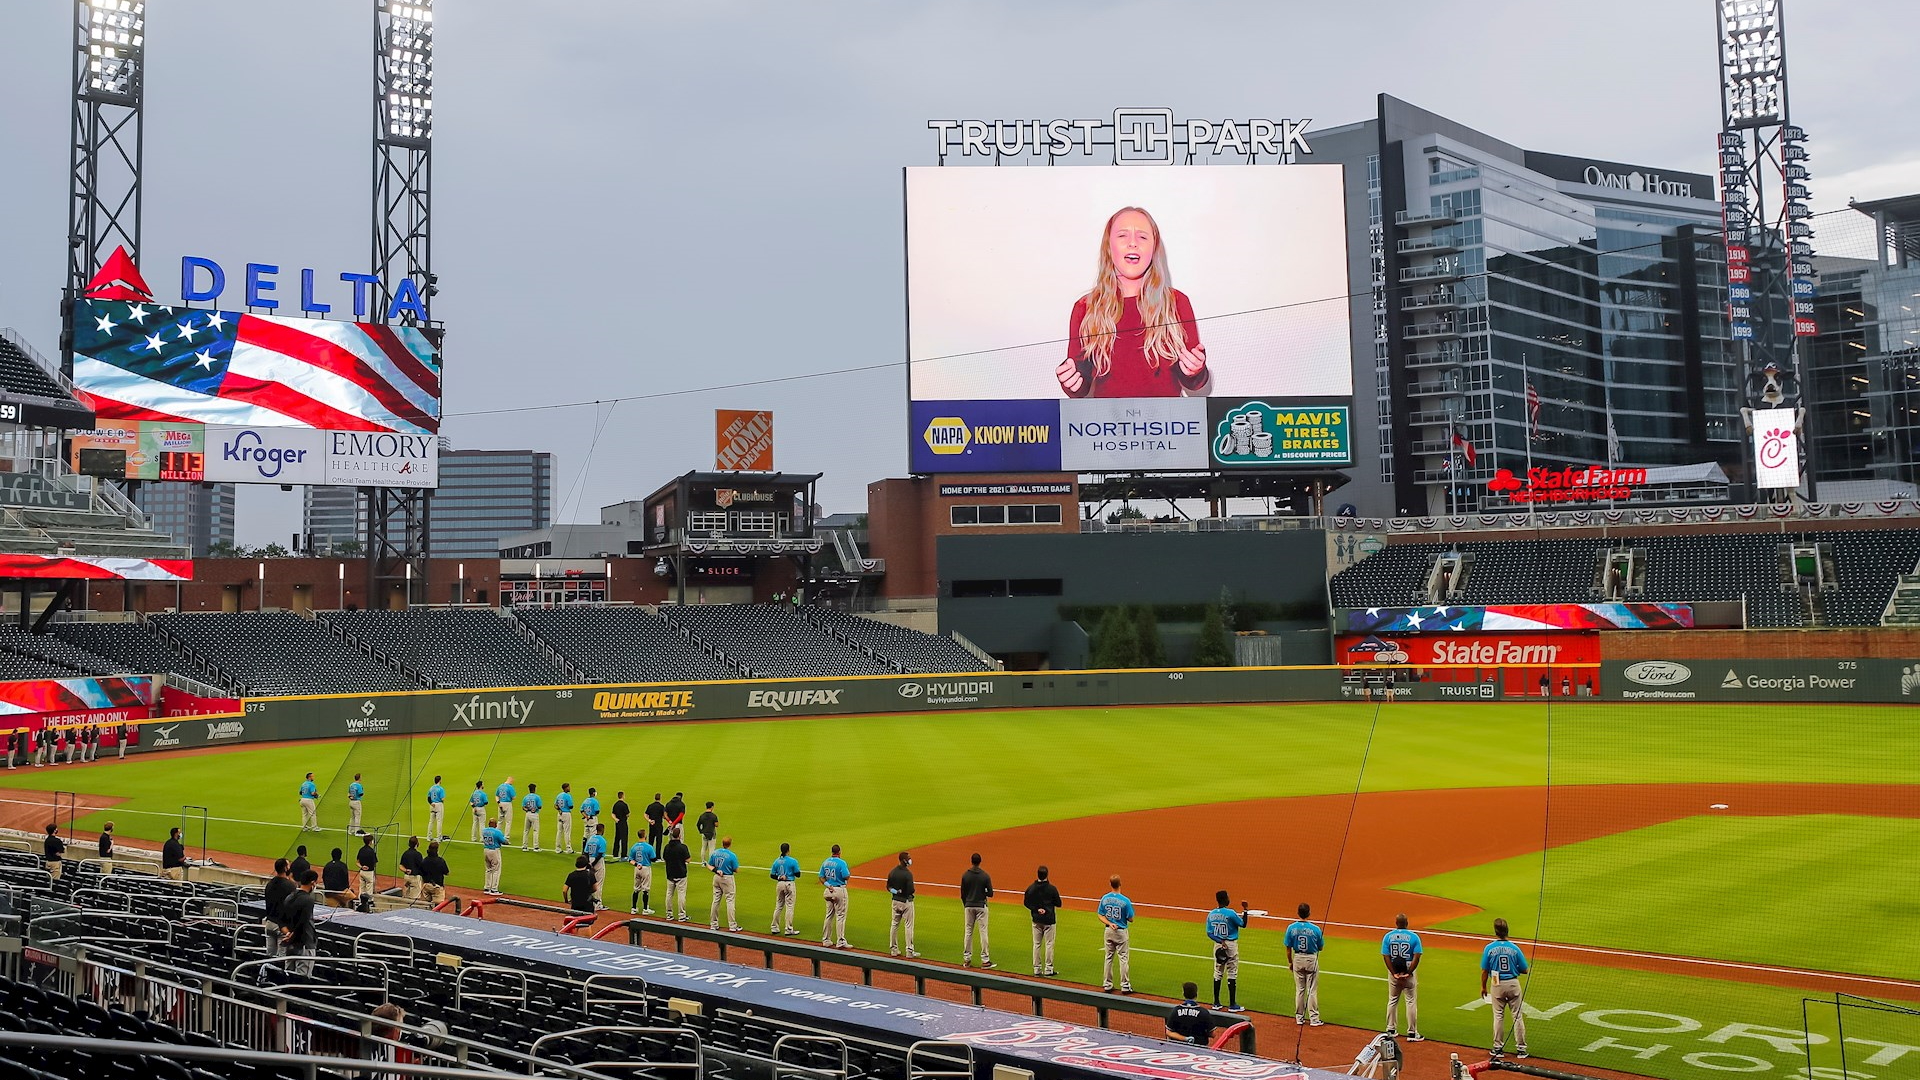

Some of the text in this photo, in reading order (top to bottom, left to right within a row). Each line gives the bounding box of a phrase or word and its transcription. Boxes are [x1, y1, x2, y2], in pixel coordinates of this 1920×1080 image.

[928, 118, 1313, 156] TRUIST PARK
[1784, 129, 1802, 139] 1873
[1722, 136, 1740, 146] 1872
[1785, 148, 1803, 158] 1875
[1723, 155, 1741, 165] 1874
[1786, 168, 1805, 178] 1878
[1584, 165, 1693, 198] OMNI HOTEL
[1724, 174, 1742, 184] 1877
[1788, 187, 1806, 197] 1891
[1725, 193, 1745, 203] 1883
[1727, 212, 1745, 222] 1892
[1789, 208, 1808, 217] 1893
[1728, 231, 1746, 241] 1897
[1729, 250, 1747, 260] 1914
[1791, 245, 1810, 255] 1948
[1730, 269, 1748, 279] 1957
[1793, 264, 1812, 274] 1958
[181, 256, 427, 321] DELTA
[1731, 288, 1750, 298] 1969
[1794, 283, 1813, 294] 1982
[1733, 307, 1751, 317] 1991
[1795, 303, 1814, 313] 1992
[1734, 327, 1753, 337] 1993
[1797, 322, 1816, 333] 1995
[0, 405, 16, 419] 59
[1126, 409, 1141, 417] NH
[1276, 412, 1342, 426] MAVIS
[722, 416, 746, 440] THE
[1068, 421, 1201, 437] NORTHSIDE
[1284, 428, 1329, 438] TIRES
[165, 431, 191, 441] MEGA
[932, 427, 964, 445] NAPA
[974, 425, 1049, 444] KNOW HOW
[717, 411, 772, 469] HOME
[1282, 440, 1339, 449] BRAKES
[332, 433, 433, 458] EMORY
[1093, 441, 1177, 451] HOSPITAL
[224, 431, 307, 477] Kroger
[739, 433, 772, 470] DEPOT
[332, 461, 429, 474] HEALTHCARE
[161, 471, 203, 480] MILLION
[1510, 487, 1631, 503] NEIGHBORHOOD
[707, 567, 739, 575] SLICE
[1838, 662, 1857, 670] 375
[1638, 666, 1677, 681] Ford
[1747, 674, 1856, 691] Georgia Power
[927, 682, 993, 695] HYUNDAI
[1440, 687, 1478, 695] TRUIST
[556, 691, 573, 699] 385
[927, 696, 978, 704] BuyHyundai.com
[593, 691, 693, 710] QUIKRETE
[748, 690, 840, 711] EQUIFAX
[246, 703, 265, 713] 375
[453, 695, 535, 727] xfinity
[42, 712, 128, 728] THE FIRST AND ONLY
[346, 718, 390, 729] Wellstar
[1105, 905, 1121, 920] 33
[1211, 922, 1228, 936] 70
[1298, 936, 1308, 950] 3
[1391, 942, 1410, 958] 82
[1499, 955, 1510, 971] 8
[490, 934, 617, 959] TRUIST
[657, 964, 768, 989] PARK
[774, 987, 852, 1005] HOME
[847, 1000, 889, 1011] OF
[885, 1007, 943, 1021] THE
[1177, 1009, 1200, 1017] BAT BOY
